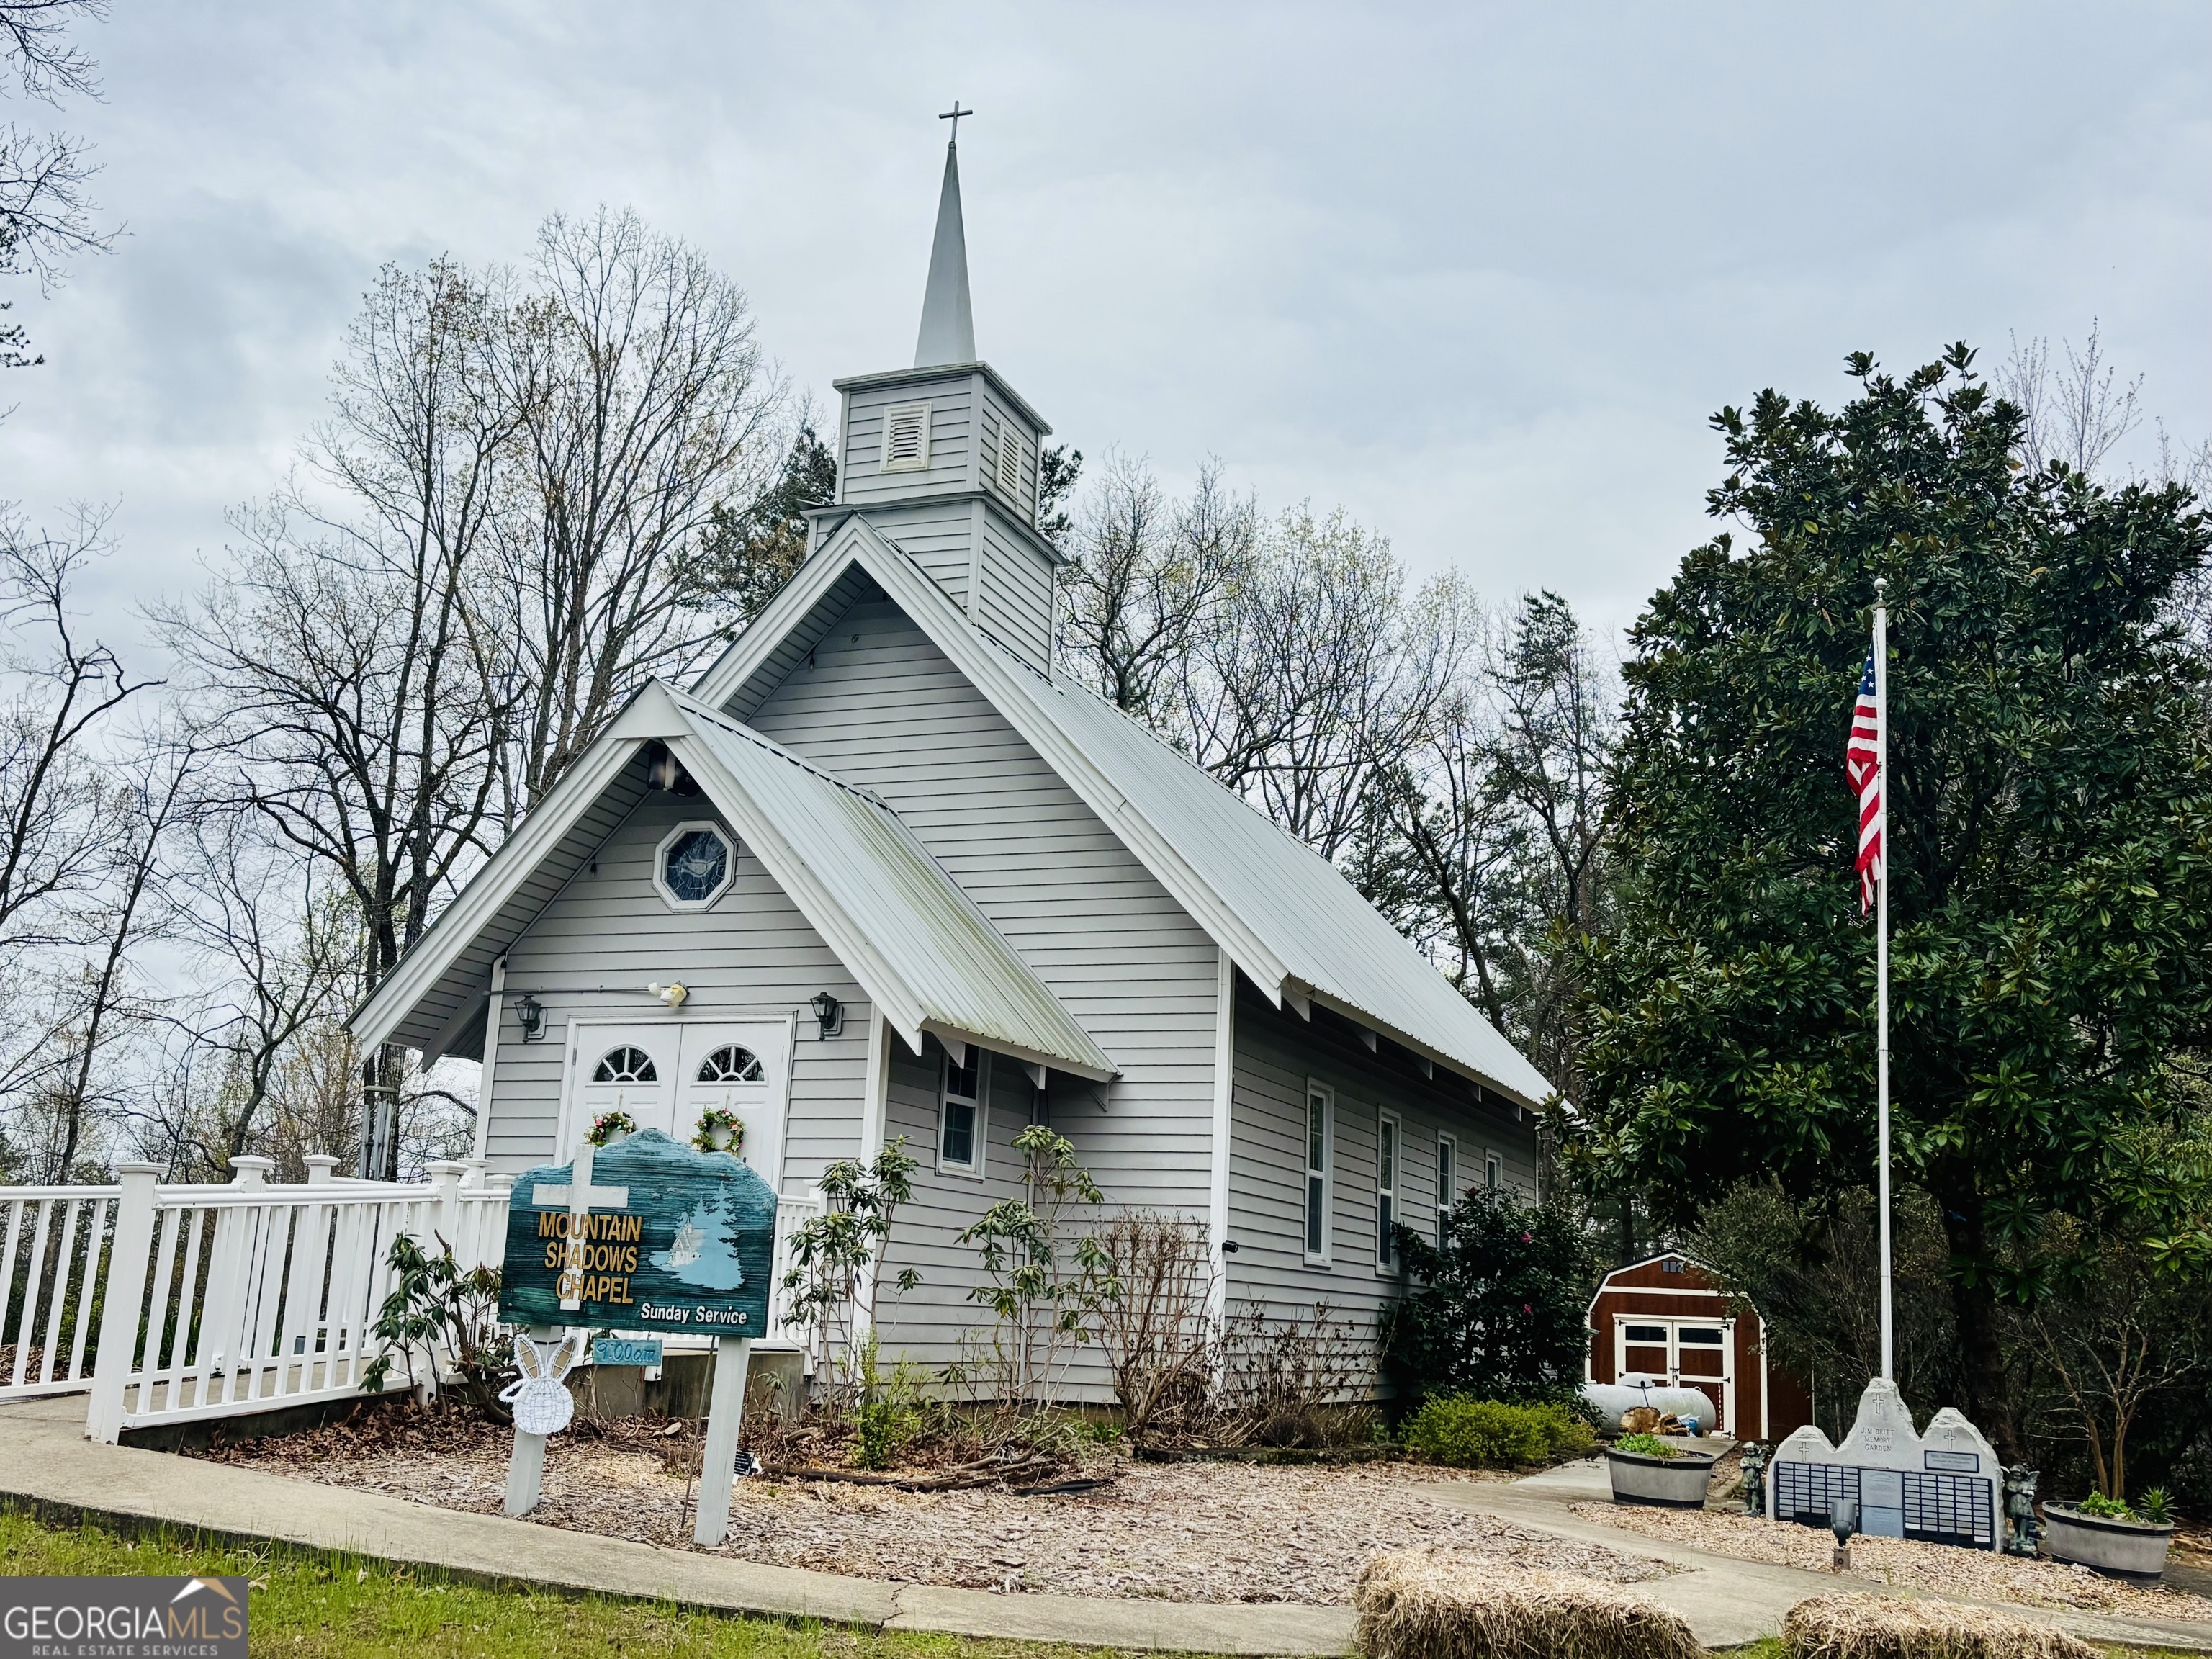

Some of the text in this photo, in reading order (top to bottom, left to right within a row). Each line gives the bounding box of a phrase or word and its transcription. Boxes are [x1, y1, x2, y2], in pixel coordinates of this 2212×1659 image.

[539, 1212, 642, 1241] MOUNTAIN
[544, 1241, 638, 1273] SHADOWS
[556, 1272, 634, 1304] CHAPEL
[641, 1303, 747, 1325] Sunday Service
[1864, 1435, 1892, 1444] MEMORY
